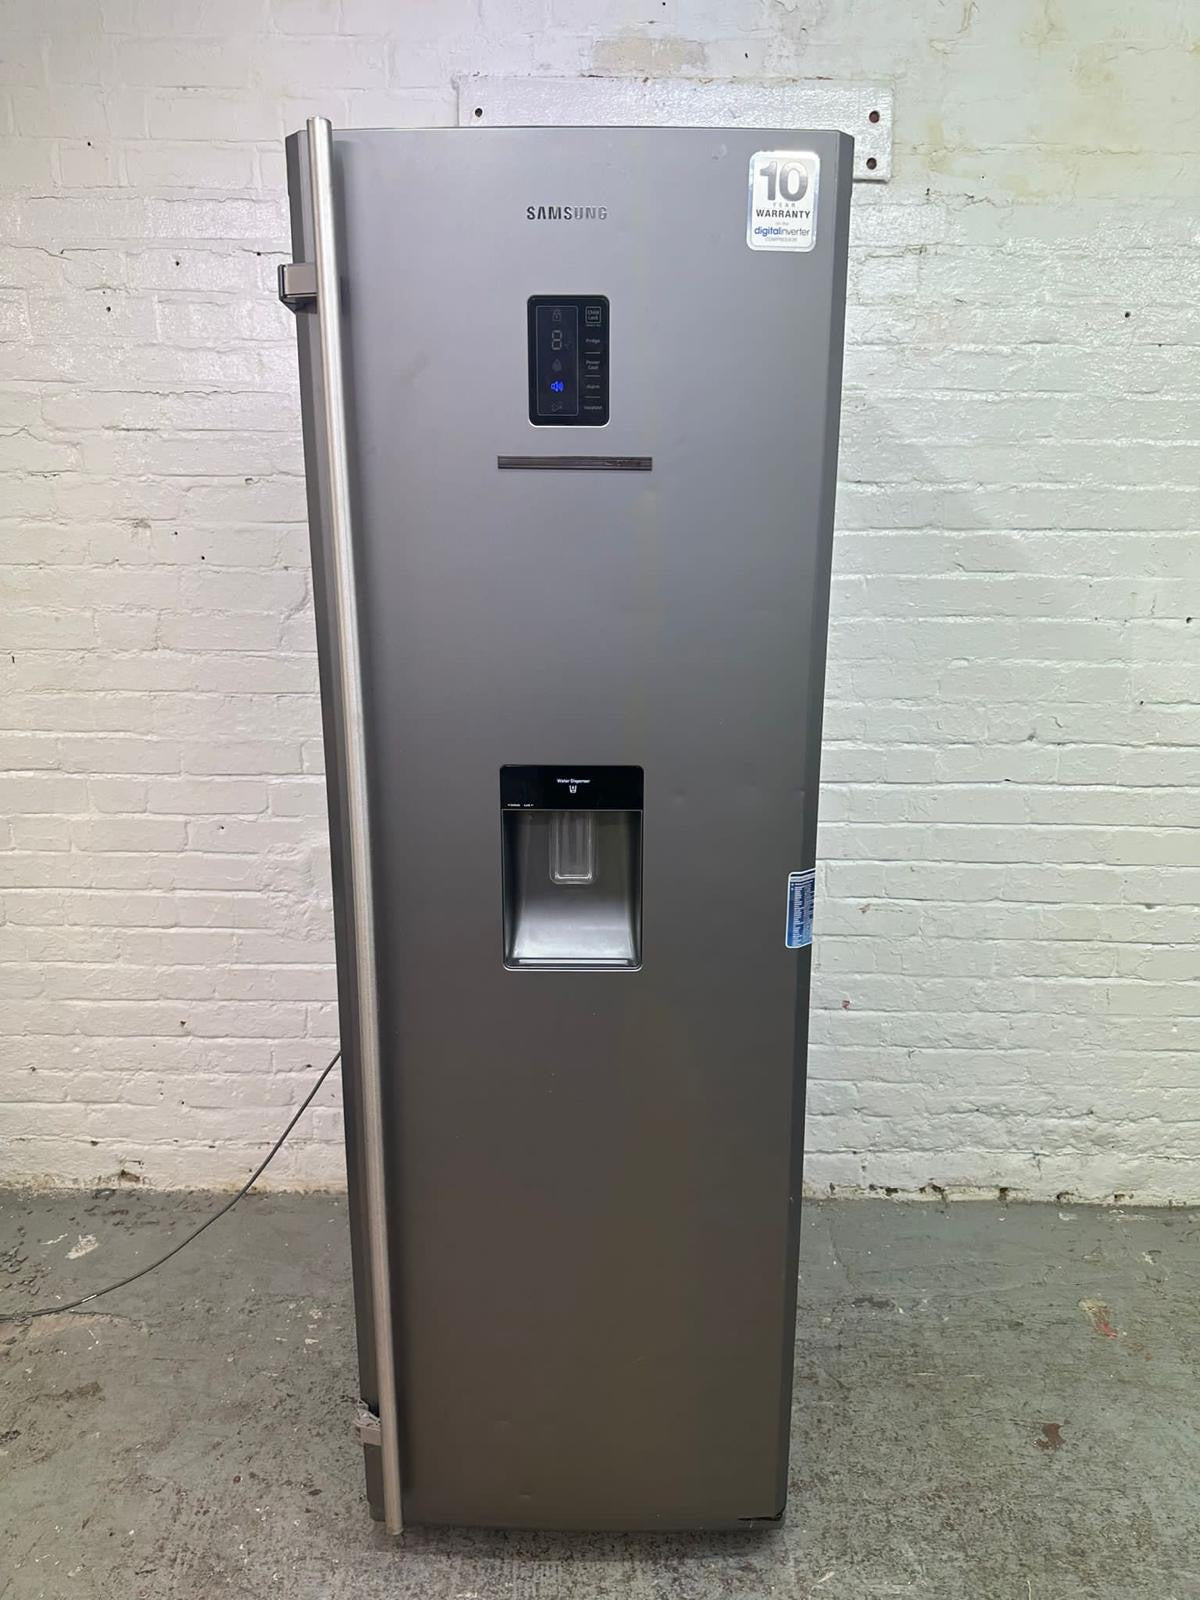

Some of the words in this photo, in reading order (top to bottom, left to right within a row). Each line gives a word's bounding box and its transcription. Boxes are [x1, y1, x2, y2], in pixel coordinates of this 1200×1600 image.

[760, 160, 809, 201] 10
[526, 206, 608, 220] SAMSUNG
[755, 209, 811, 219] WARRANTY
